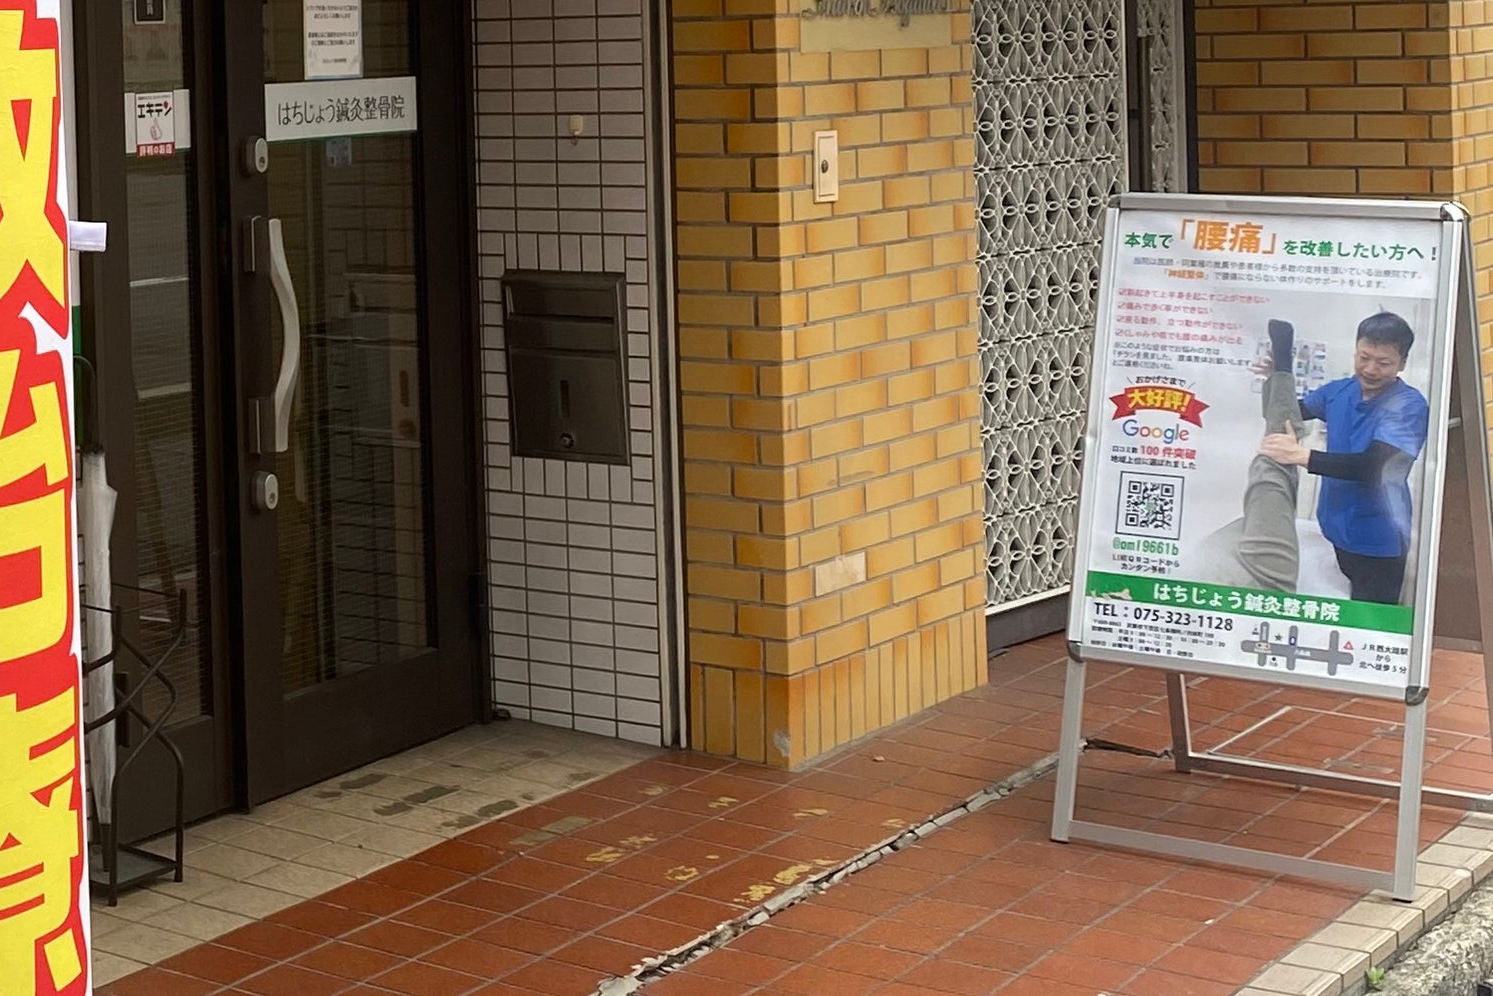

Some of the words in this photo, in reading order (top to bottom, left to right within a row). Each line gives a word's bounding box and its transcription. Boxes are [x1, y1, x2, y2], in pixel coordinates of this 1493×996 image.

[277, 95, 405, 126] はちじょう鍼灸整骨院
[1135, 375, 1187, 386] おかげさまで
[1122, 419, 1190, 444] Google
[1153, 583, 1341, 622] はちじょう鍼灸整骨院
